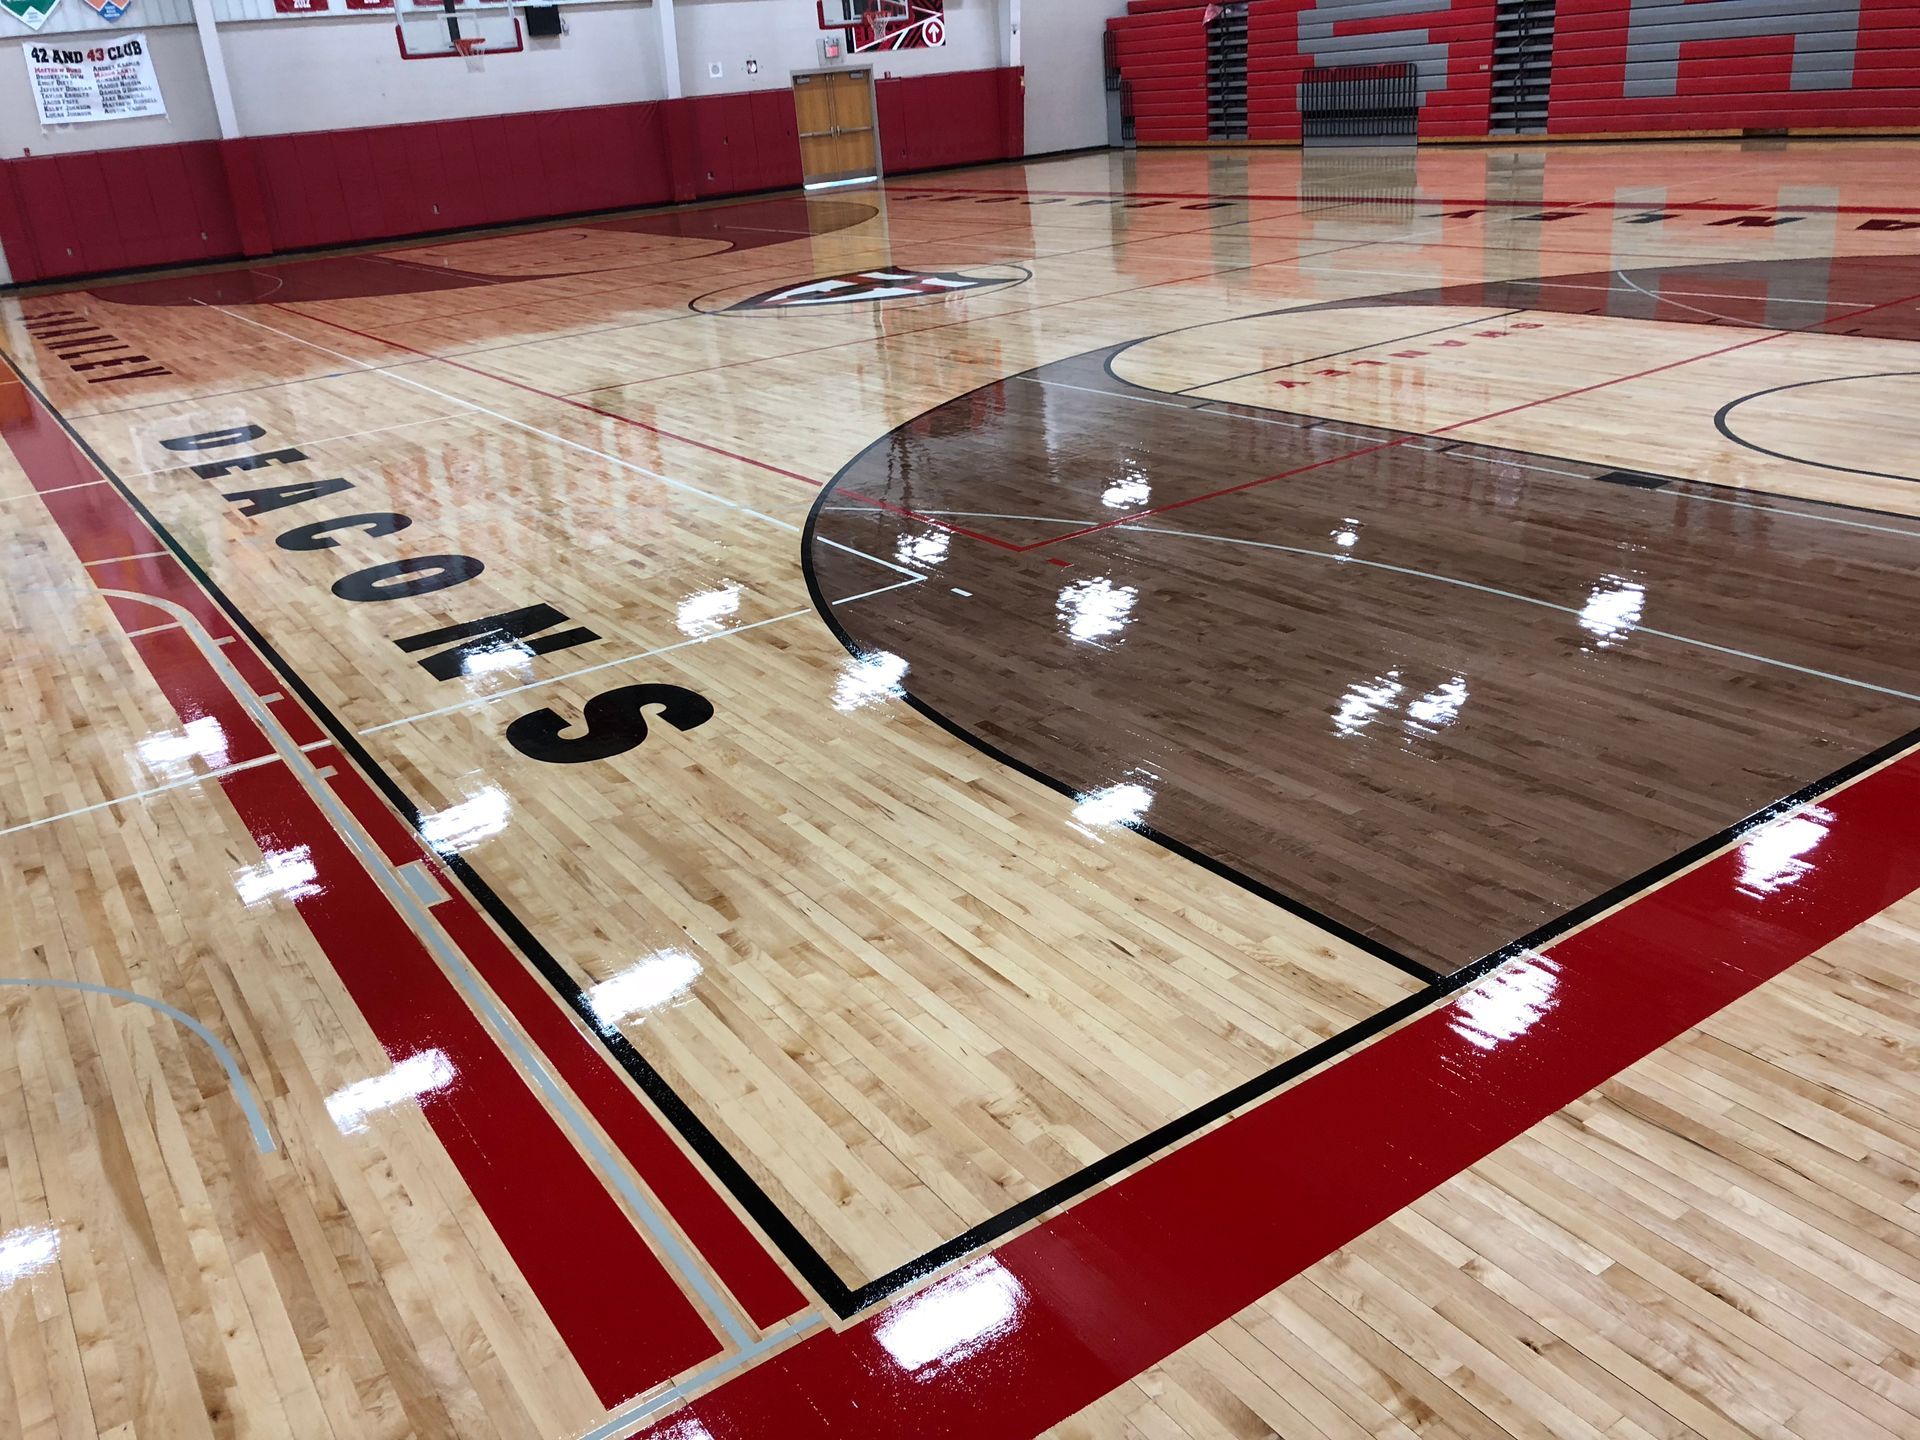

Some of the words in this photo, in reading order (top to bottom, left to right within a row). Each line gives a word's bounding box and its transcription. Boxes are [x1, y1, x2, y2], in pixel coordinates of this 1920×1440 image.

[31, 47, 50, 63] 42
[52, 49, 84, 64] AND
[86, 48, 105, 62] 43
[107, 40, 142, 61] CLUB
[1274, 322, 1544, 389] SHANLEY
[17, 311, 173, 384] SHANLEY
[159, 424, 714, 764] DEACONS
